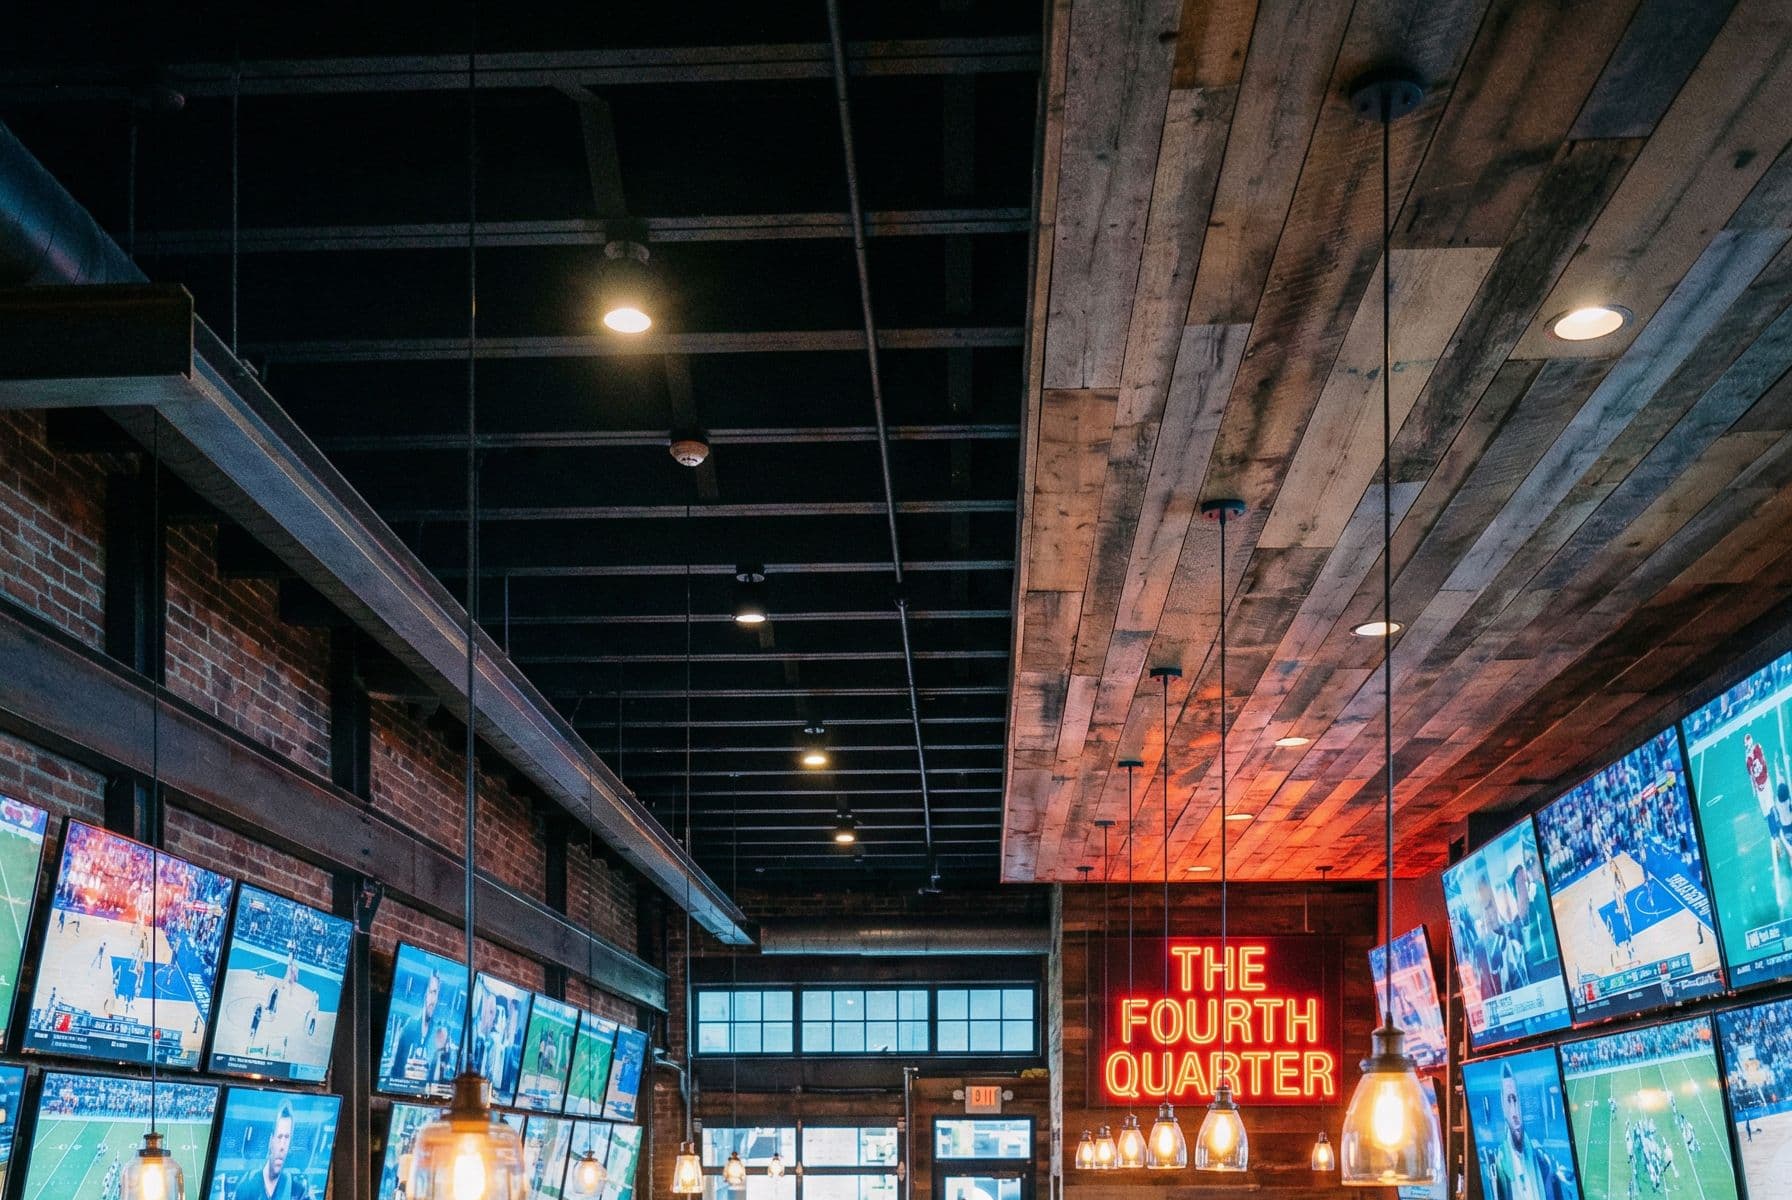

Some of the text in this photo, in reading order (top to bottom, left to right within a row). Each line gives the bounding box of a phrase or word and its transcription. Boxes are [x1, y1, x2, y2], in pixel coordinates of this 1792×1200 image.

[1171, 946, 1266, 991] THE
[1121, 998, 1317, 1044] FOURTH
[1105, 1051, 1335, 1097] QUARTER
